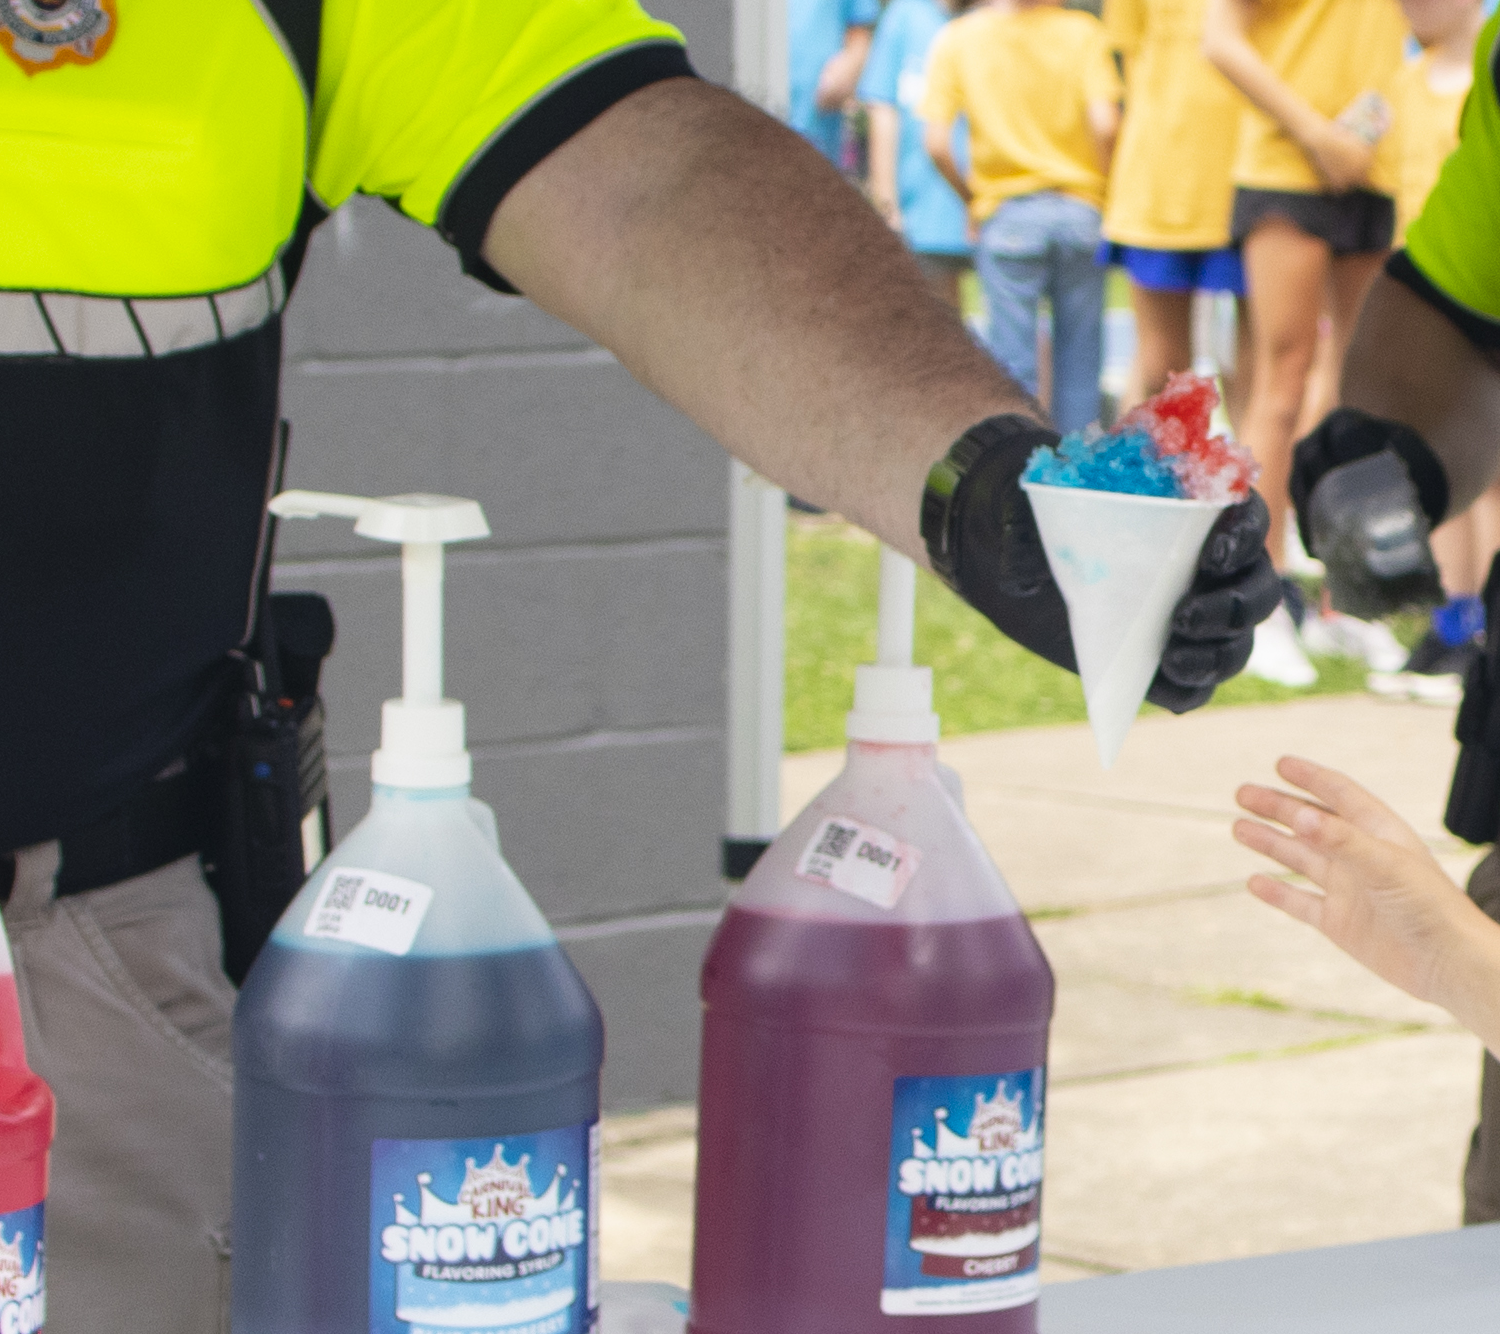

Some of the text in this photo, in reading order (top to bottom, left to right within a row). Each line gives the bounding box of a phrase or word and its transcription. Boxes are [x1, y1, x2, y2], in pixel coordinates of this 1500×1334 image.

[898, 1157, 998, 1196] SNOW
[471, 1195, 525, 1220] KING
[381, 1209, 585, 1263] SNOW CONE
[422, 1262, 517, 1281] FLAVORING
